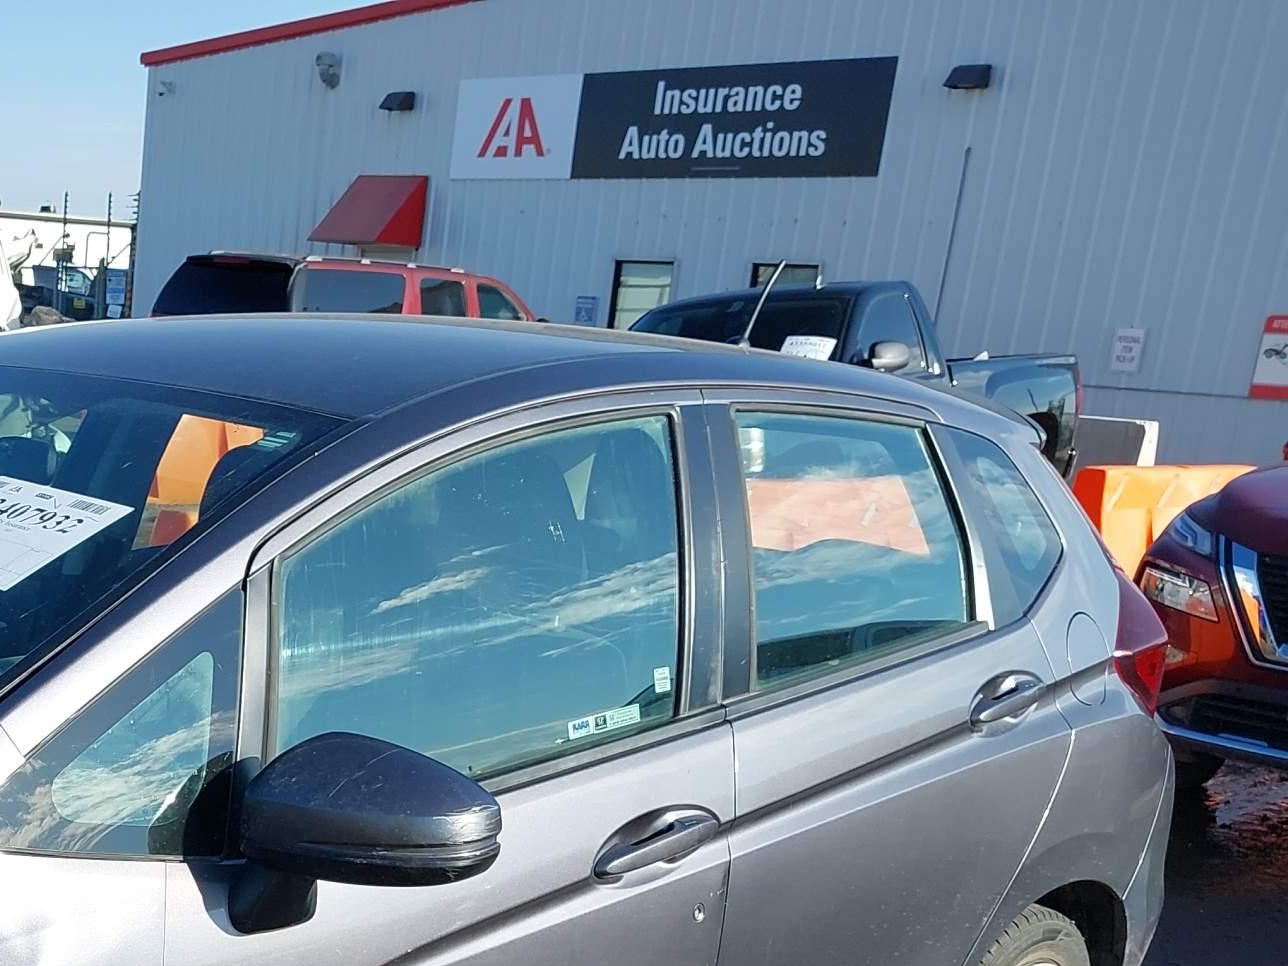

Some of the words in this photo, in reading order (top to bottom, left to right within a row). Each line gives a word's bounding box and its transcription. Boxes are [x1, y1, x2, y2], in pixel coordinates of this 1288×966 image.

[654, 80, 802, 115] Insurance
[618, 126, 686, 160] Auto
[692, 121, 826, 158] Auctions
